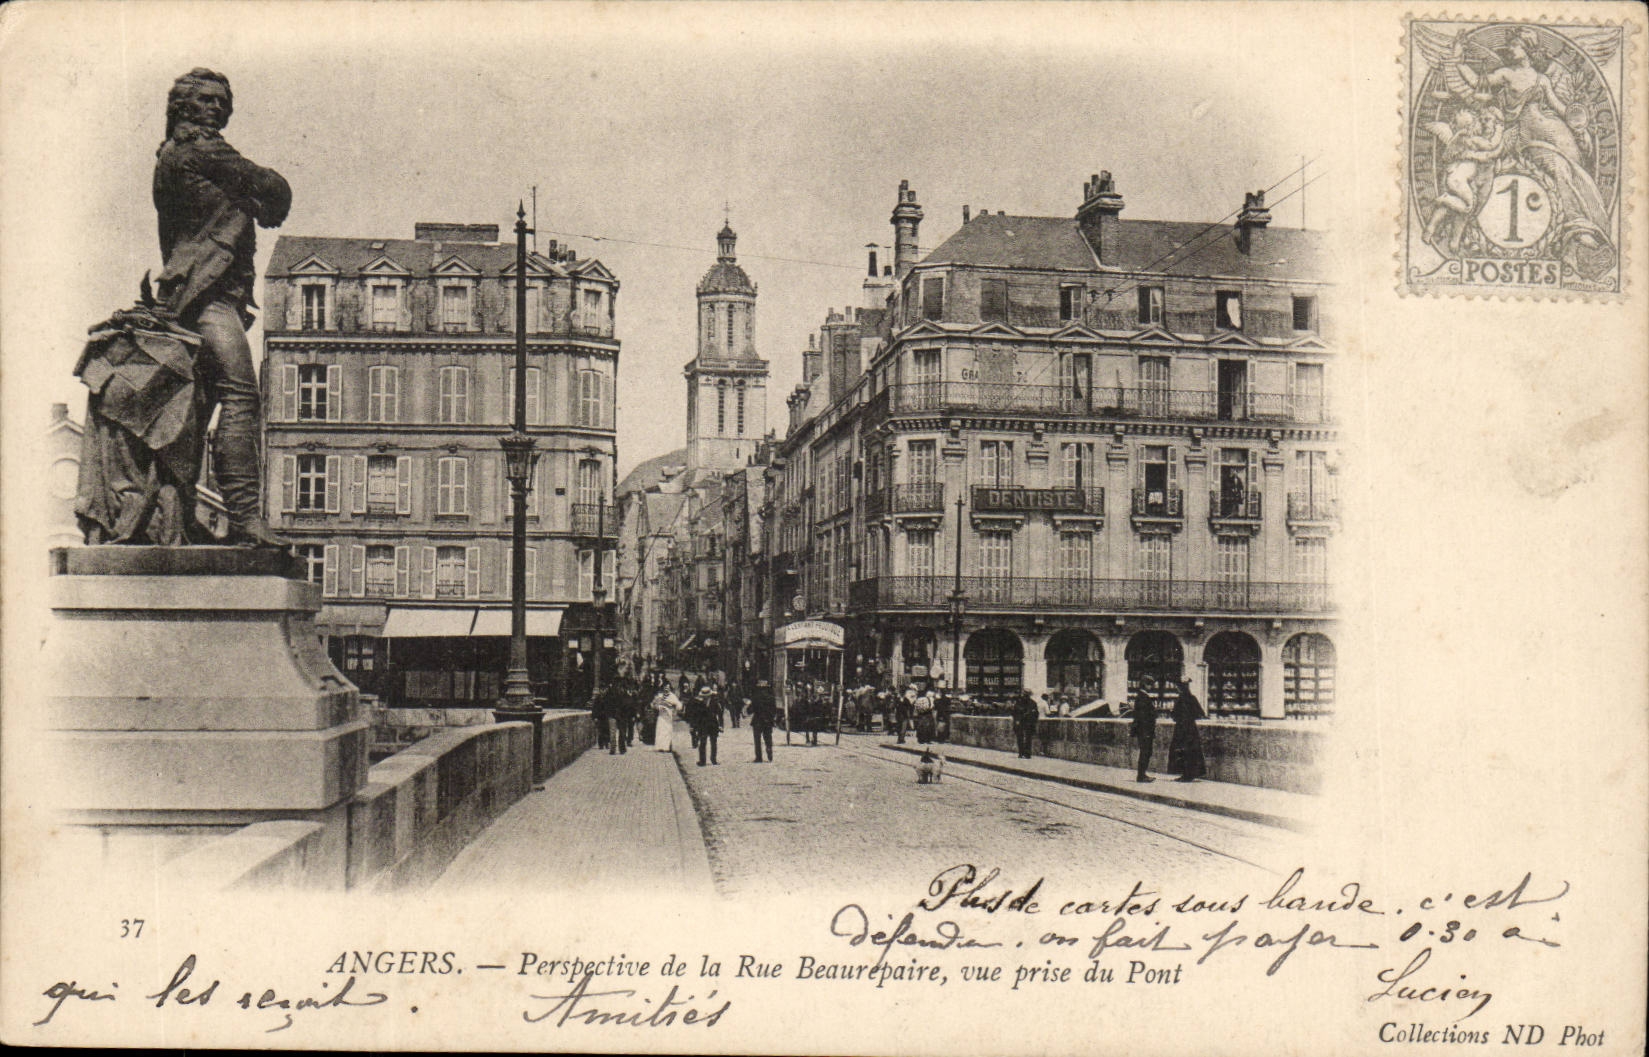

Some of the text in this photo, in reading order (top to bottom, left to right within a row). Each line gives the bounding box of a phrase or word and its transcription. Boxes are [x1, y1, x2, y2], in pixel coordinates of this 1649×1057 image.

[1465, 259, 1558, 285] POSTES
[988, 490, 1076, 507] DENTISTE
[1059, 880, 1161, 916] cartes
[1171, 894, 1249, 914] sous
[1419, 871, 1570, 910] c'est
[1088, 917, 1191, 959] fait
[1197, 920, 1379, 976] payer
[32, 981, 118, 1026] qui
[146, 954, 220, 1008] les
[523, 970, 731, 1028] Amitiés
